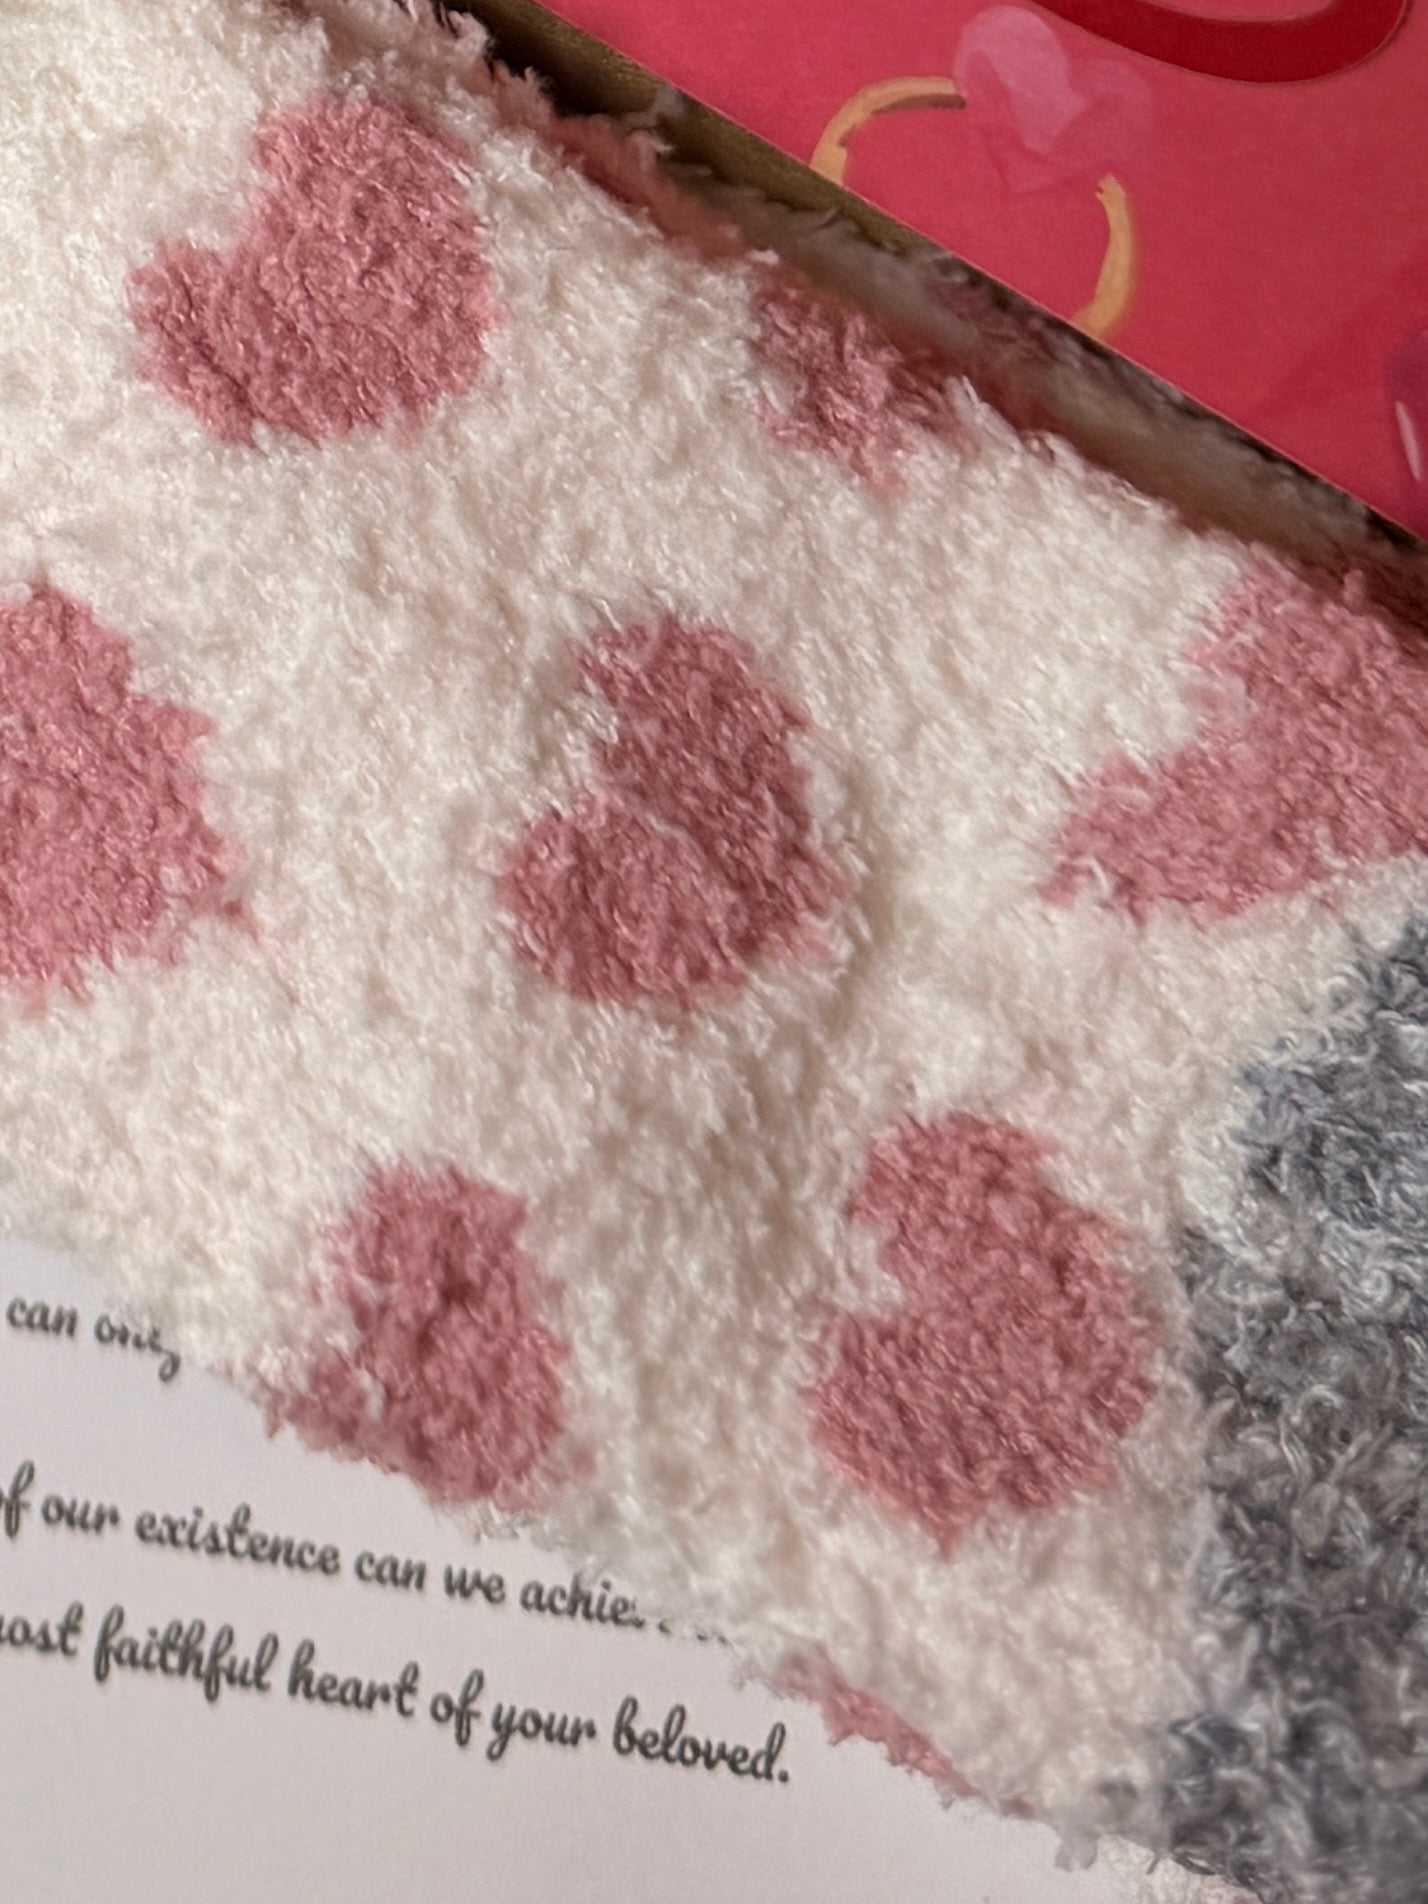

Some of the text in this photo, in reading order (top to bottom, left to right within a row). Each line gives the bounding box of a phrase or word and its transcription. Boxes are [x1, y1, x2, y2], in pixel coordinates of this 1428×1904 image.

[6, 1295, 79, 1341] can
[41, 1491, 121, 1537] our
[135, 1502, 342, 1580] existence
[353, 1548, 428, 1594] can
[443, 1566, 507, 1609] we
[93, 1603, 280, 1705] faithful
[287, 1638, 421, 1720] heart
[429, 1669, 486, 1750] of
[487, 1702, 598, 1772] your
[612, 1694, 791, 1787] beloved.
